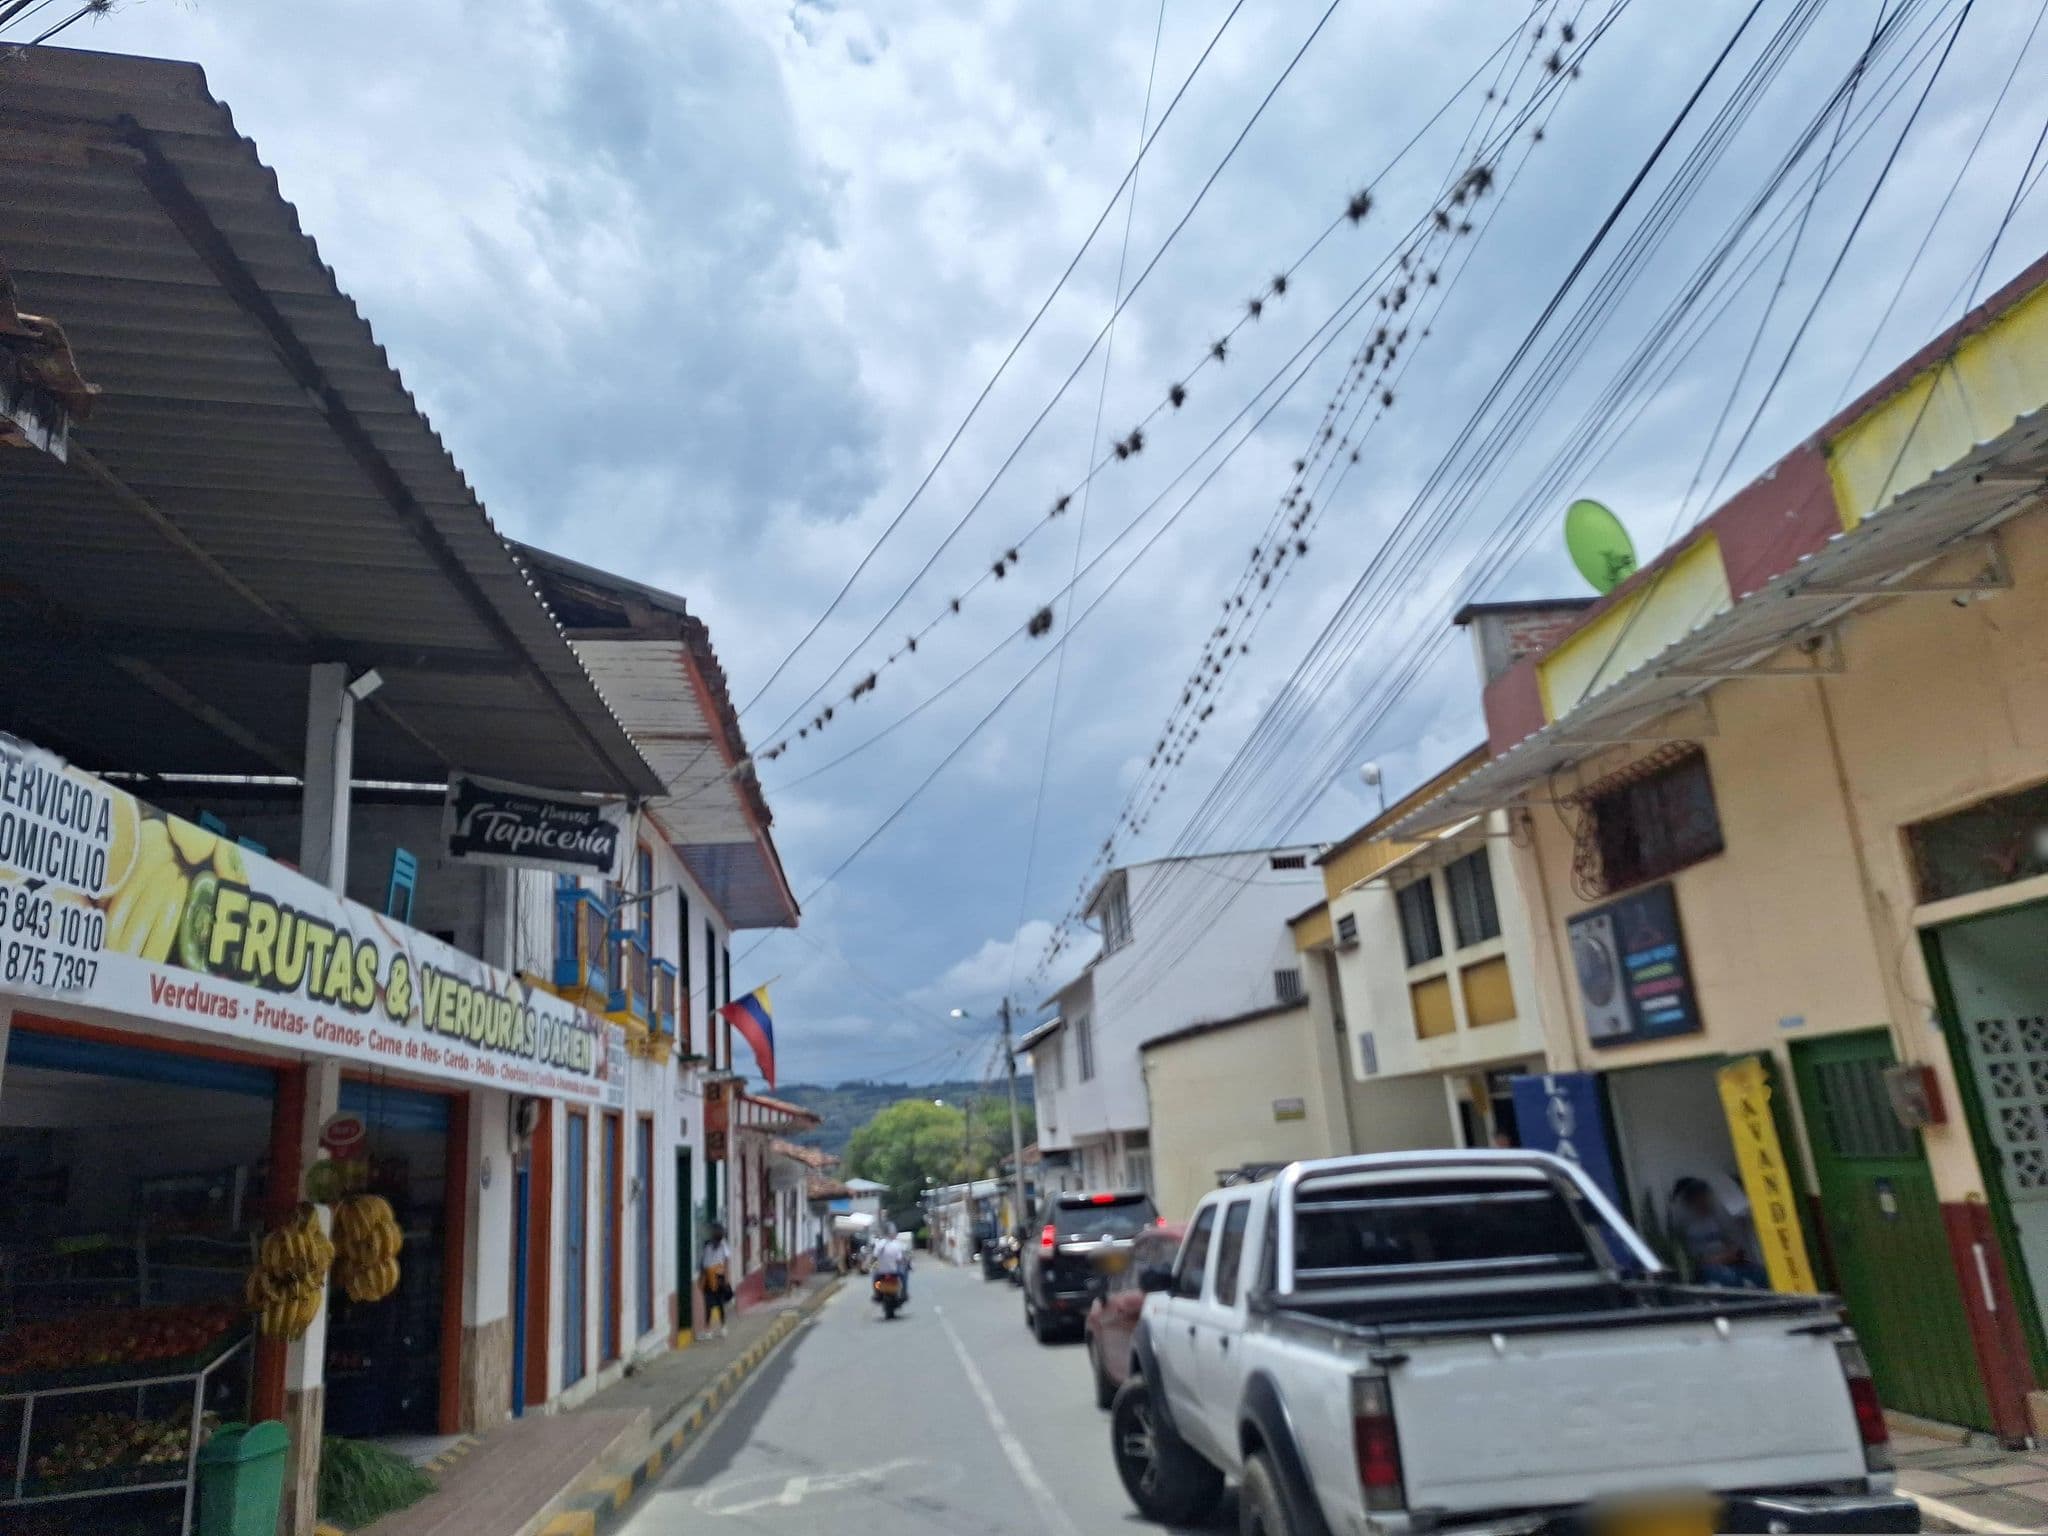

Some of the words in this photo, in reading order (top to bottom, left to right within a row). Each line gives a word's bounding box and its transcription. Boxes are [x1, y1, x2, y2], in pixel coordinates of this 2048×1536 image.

[0, 752, 92, 834] ERVICIO
[95, 798, 110, 842] A
[477, 811, 611, 855] Tapicería
[12, 892, 52, 939] 843
[59, 906, 102, 952] 1010
[5, 941, 45, 985] 875
[52, 951, 98, 990] 7397
[208, 882, 378, 1013] FRUTAS
[386, 952, 411, 1024] &
[421, 963, 535, 1060] VERDURAS
[149, 972, 238, 1020] Verduras
[368, 1029, 402, 1059] Carne
[405, 1037, 418, 1059] de
